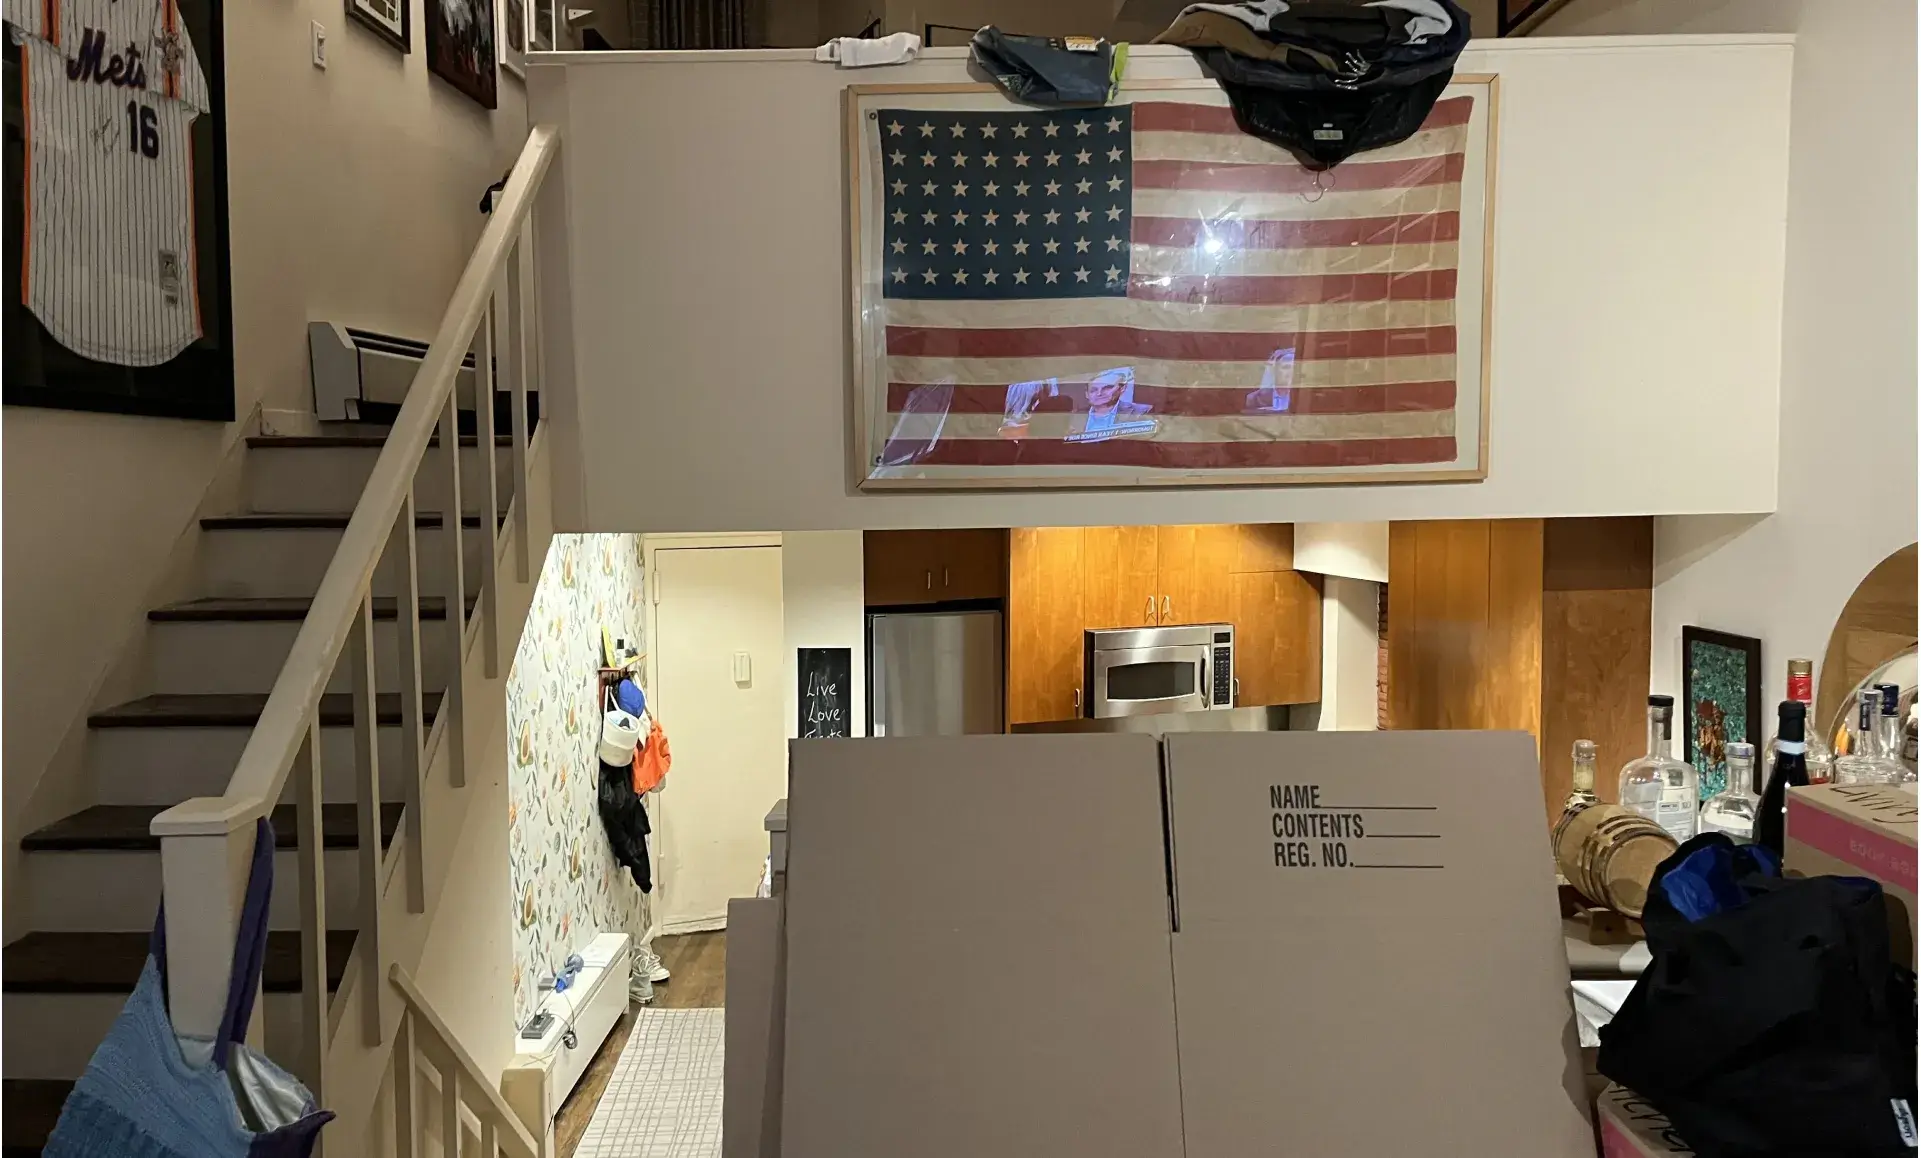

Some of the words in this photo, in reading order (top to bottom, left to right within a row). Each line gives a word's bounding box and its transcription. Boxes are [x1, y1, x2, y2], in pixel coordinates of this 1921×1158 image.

[67, 27, 146, 89] Mets
[127, 100, 159, 159] 16
[807, 671, 838, 697] Live
[808, 701, 841, 723] Love
[1269, 785, 1321, 809] NAME
[1272, 813, 1364, 838] CONTENTS
[1274, 842, 1317, 868] REG.
[1321, 842, 1354, 868] NO.
